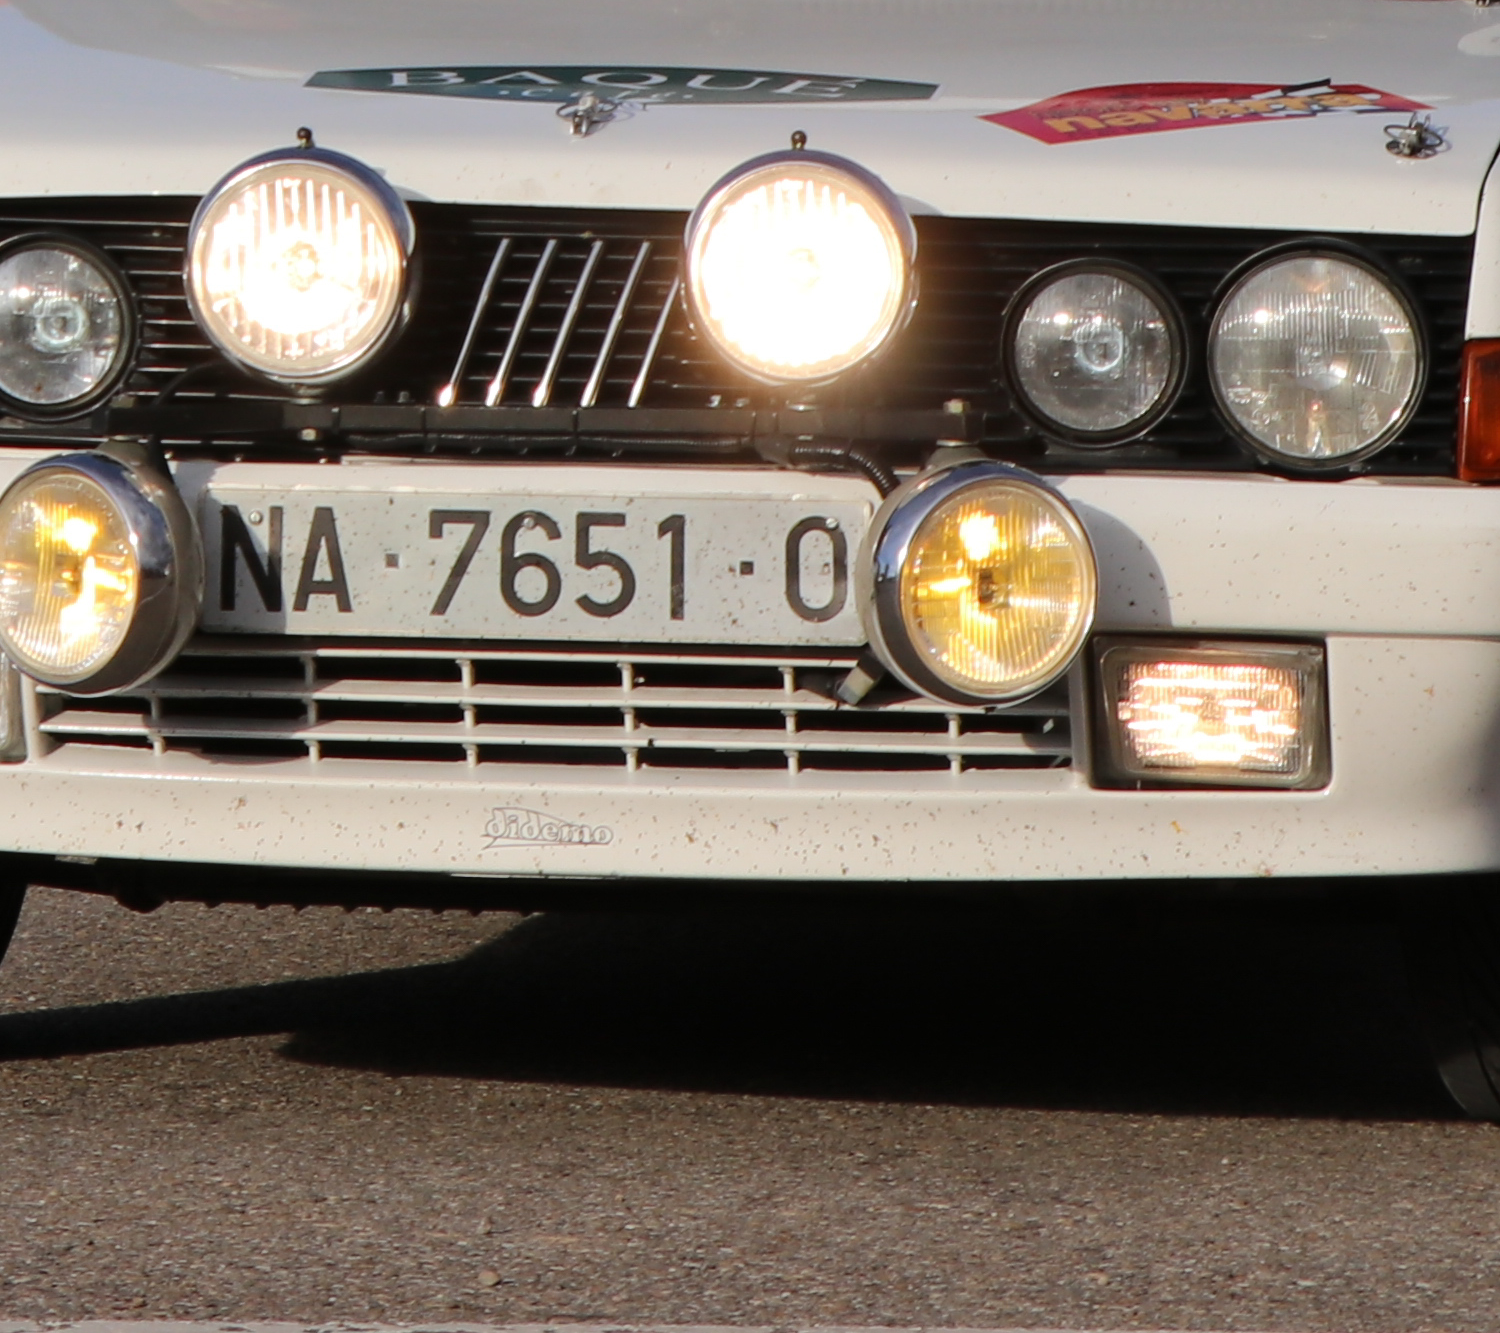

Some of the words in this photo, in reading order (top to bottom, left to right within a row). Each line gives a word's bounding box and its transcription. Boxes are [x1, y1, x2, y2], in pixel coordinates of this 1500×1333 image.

[1044, 93, 1376, 133] navarra
[220, 504, 353, 613] NA
[428, 509, 686, 621] 7651
